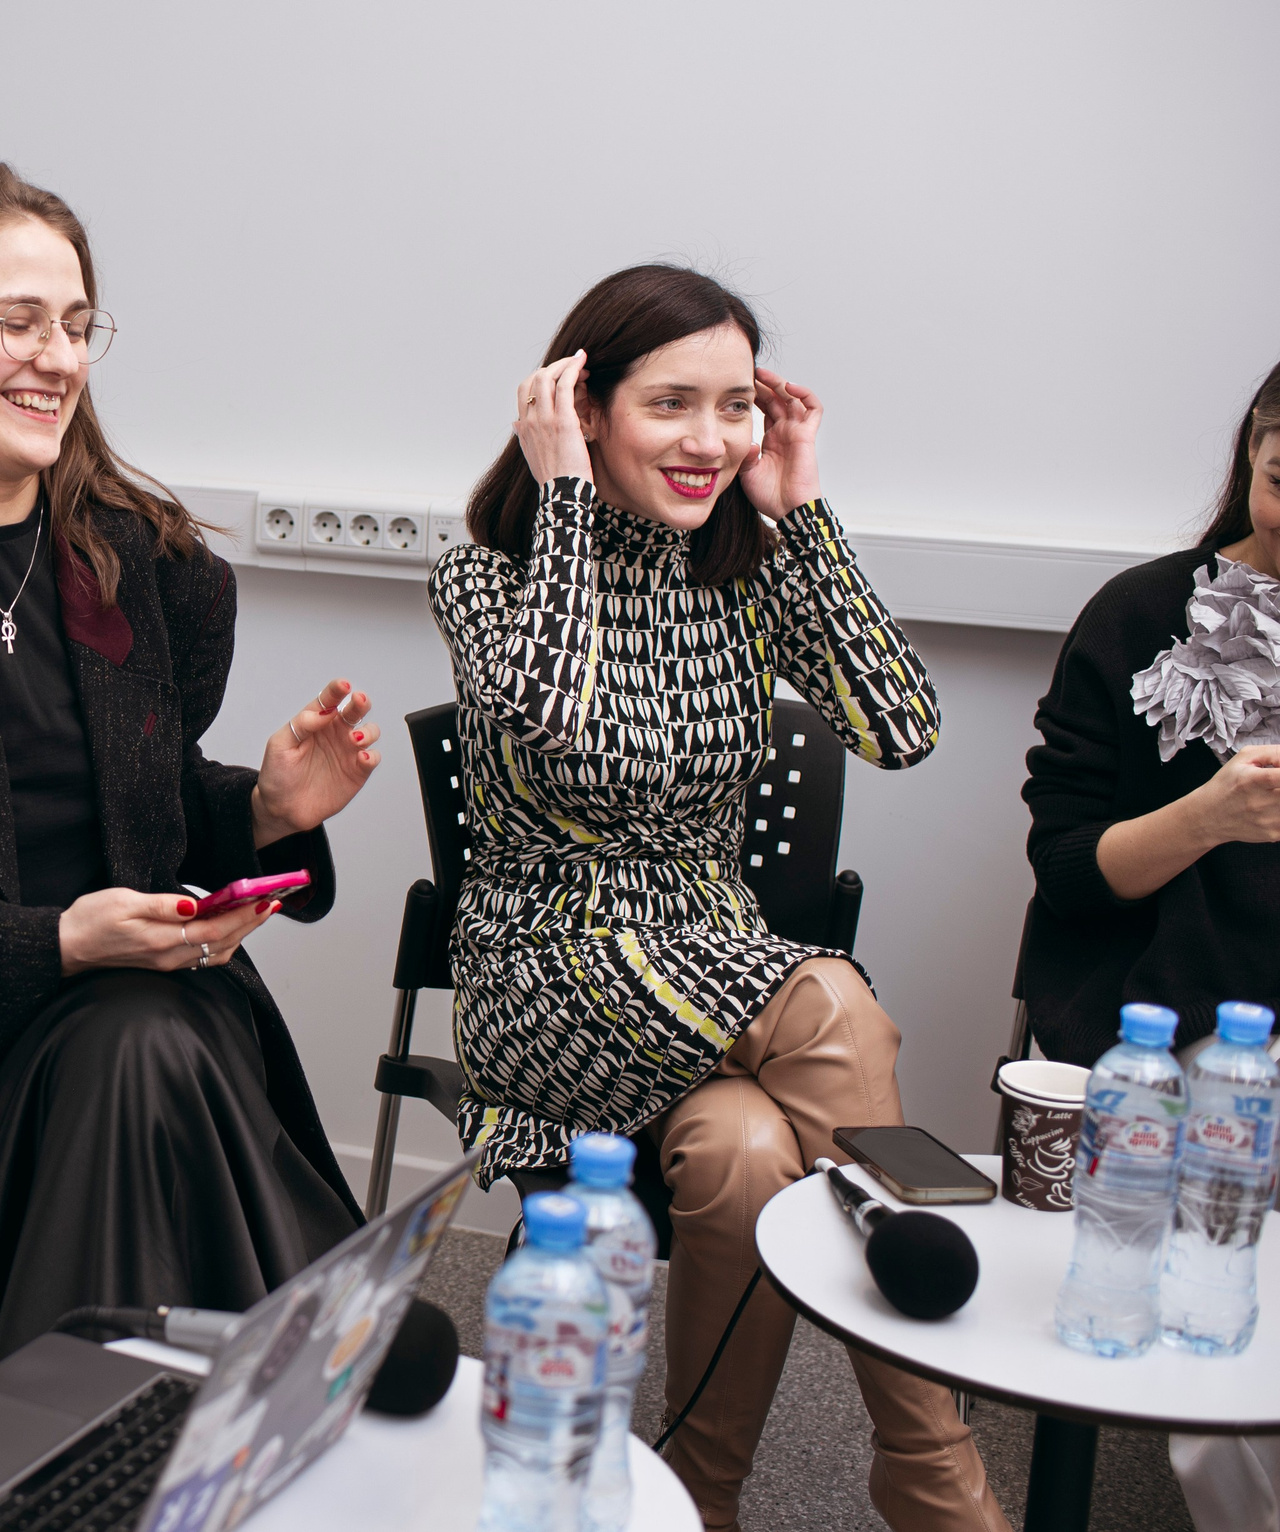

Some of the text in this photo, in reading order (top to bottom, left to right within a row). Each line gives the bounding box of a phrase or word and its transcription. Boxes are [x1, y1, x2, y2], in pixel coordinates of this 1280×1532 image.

[1046, 1110, 1073, 1119] Latte
[1021, 1127, 1064, 1146] Cappuccino
[1008, 1137, 1026, 1168] Coffee
